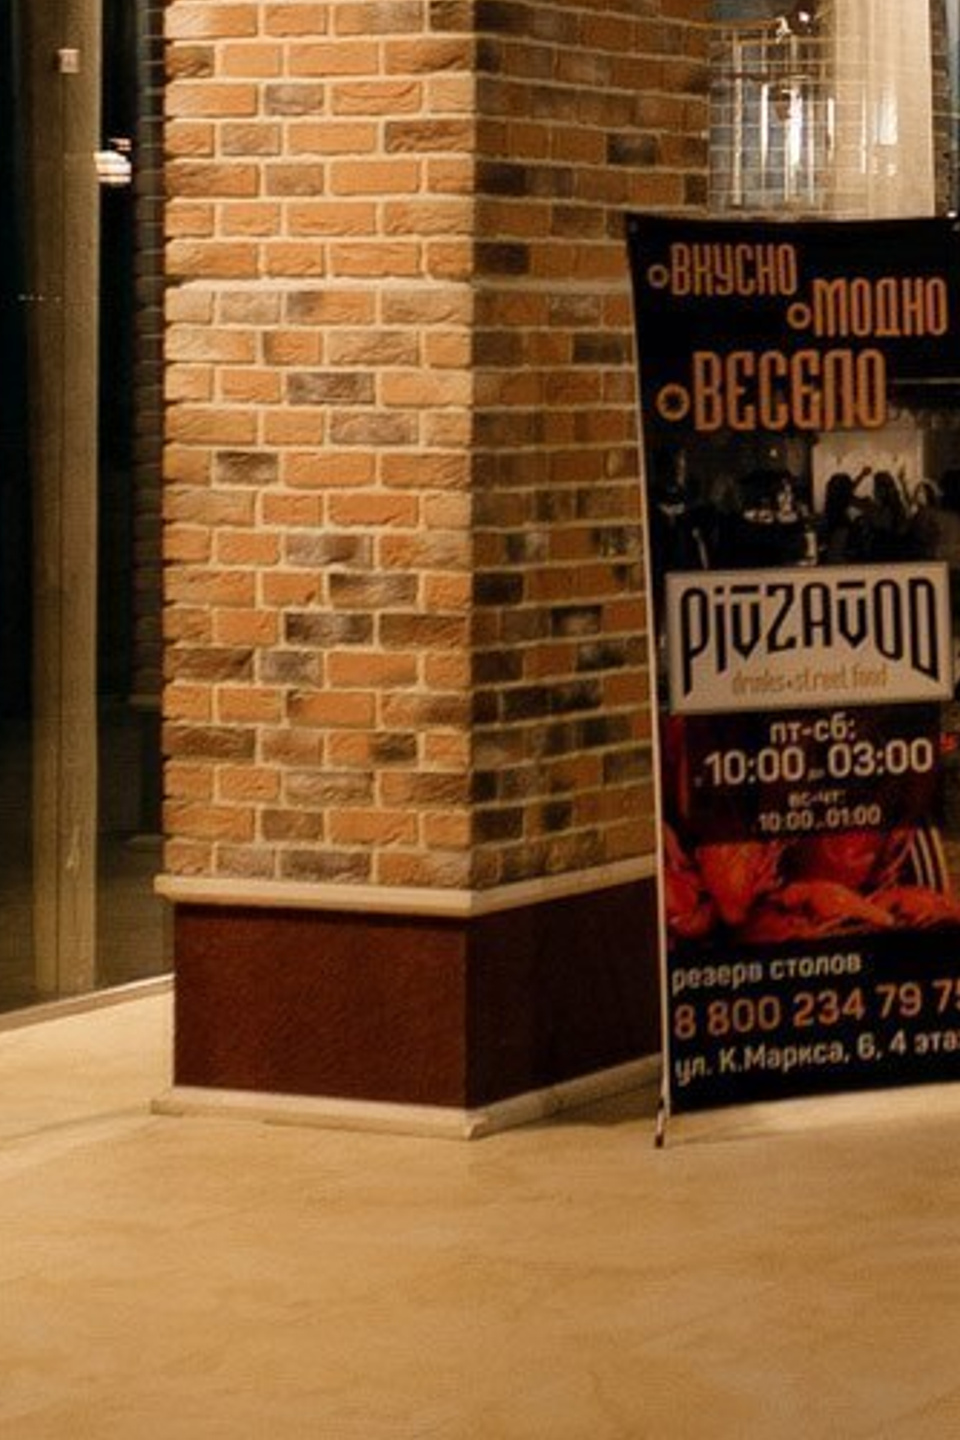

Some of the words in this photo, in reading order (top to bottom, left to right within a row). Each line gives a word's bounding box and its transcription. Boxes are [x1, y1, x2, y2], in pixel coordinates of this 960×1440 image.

[670, 243, 797, 296] ВКУСНО
[812, 277, 948, 337] МОДНО
[693, 348, 887, 432] ВЕСЕЛО
[704, 747, 805, 786] 10:00
[827, 738, 934, 777] 03:00
[671, 962, 763, 995] резерв
[769, 953, 862, 980] столов
[674, 1004, 696, 1040] 8
[706, 996, 780, 1035] 800
[792, 987, 865, 1028] 234
[875, 981, 922, 1017] 79
[857, 1032, 882, 1060] 6,
[889, 1029, 907, 1054] 4
